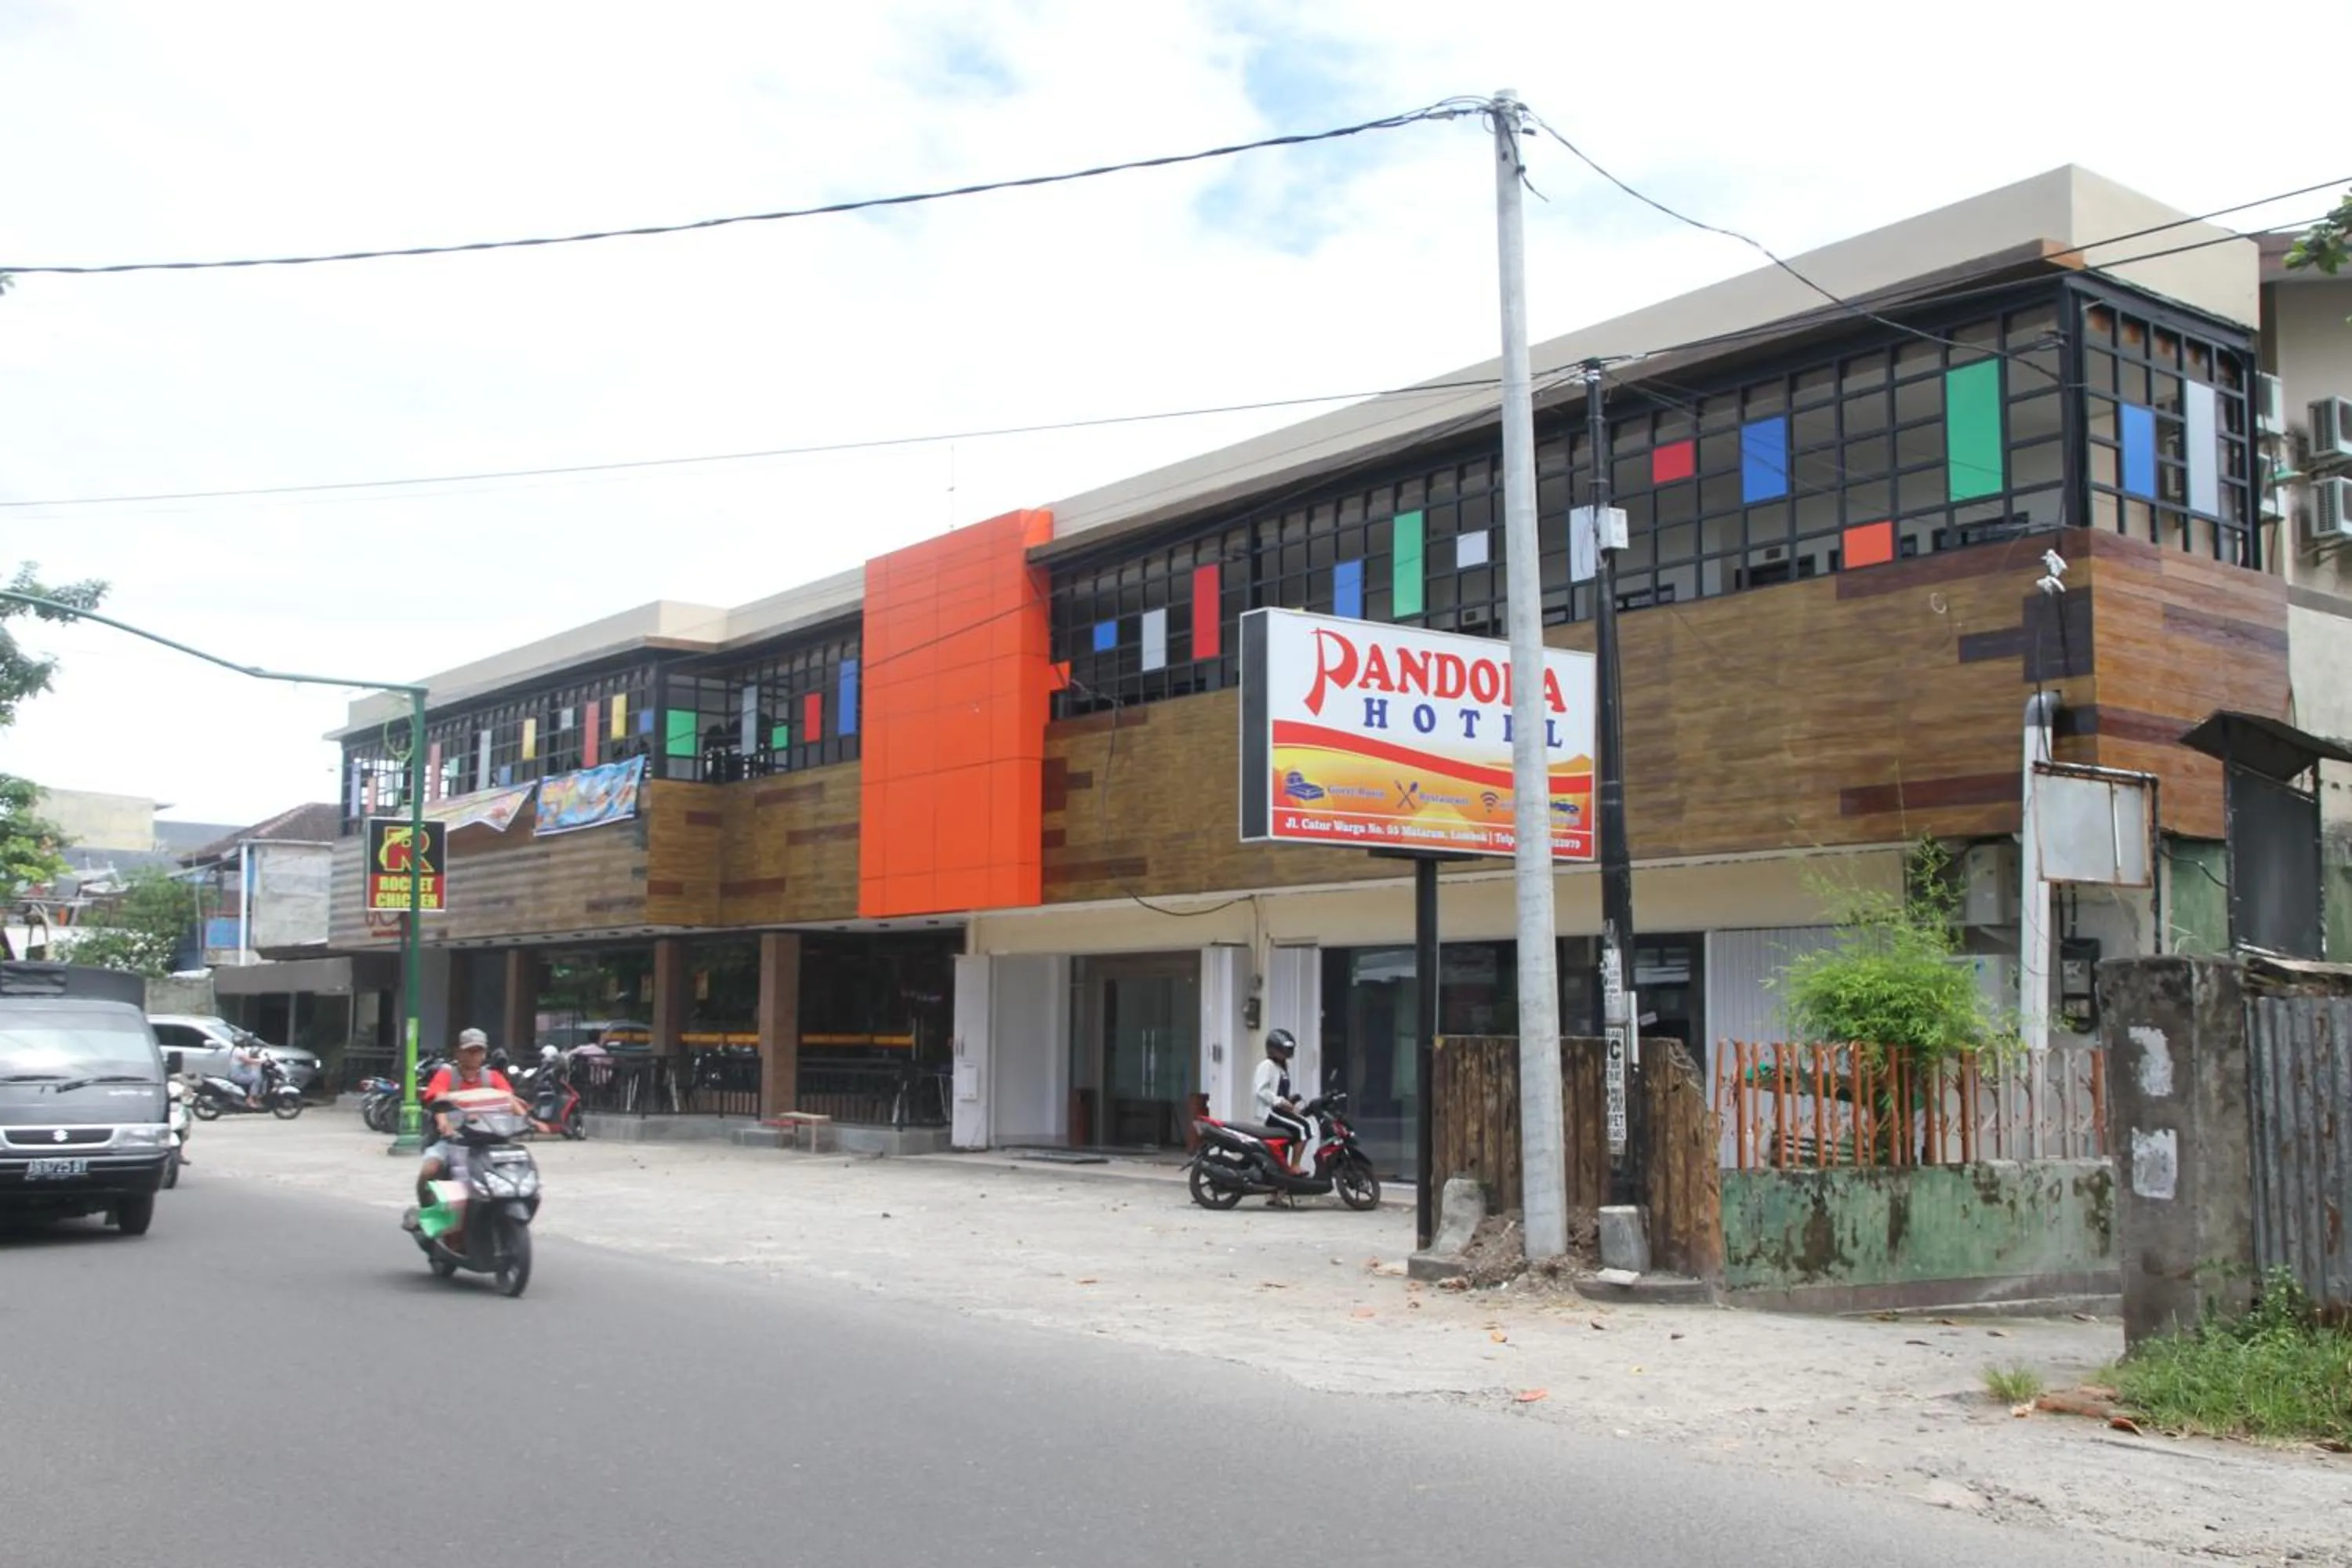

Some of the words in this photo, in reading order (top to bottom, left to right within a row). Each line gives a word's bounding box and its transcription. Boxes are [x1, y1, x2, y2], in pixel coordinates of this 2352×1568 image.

[1301, 818, 1330, 831] Catur
[1334, 820, 1365, 836] Warga
[379, 876, 435, 893] ROCET
[376, 892, 437, 908] CHICEN
